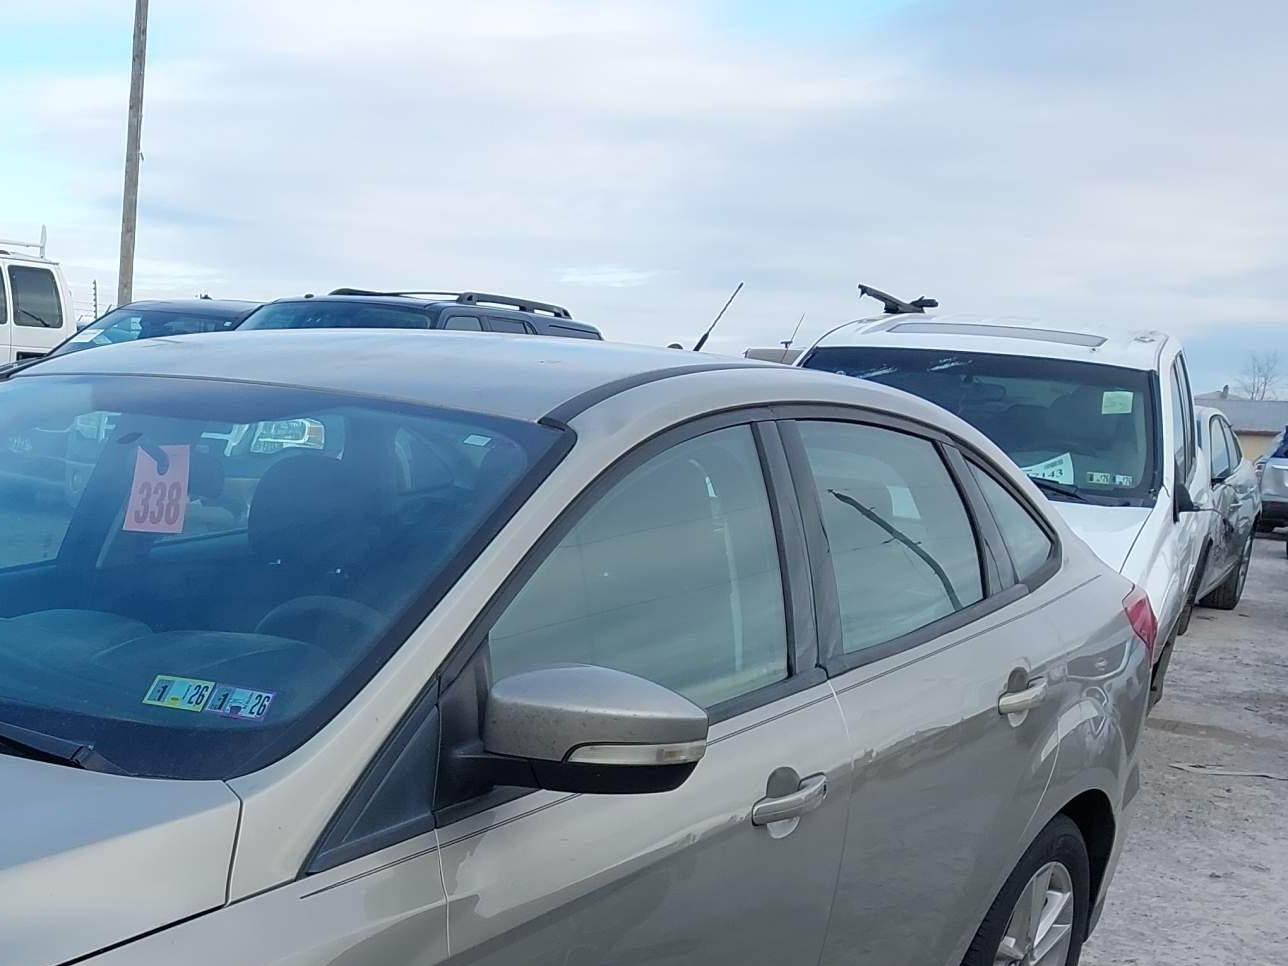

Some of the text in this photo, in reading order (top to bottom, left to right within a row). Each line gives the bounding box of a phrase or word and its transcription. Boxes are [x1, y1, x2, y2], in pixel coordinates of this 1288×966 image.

[134, 481, 183, 525] 338
[187, 684, 210, 706] 26
[248, 694, 270, 716] 26
